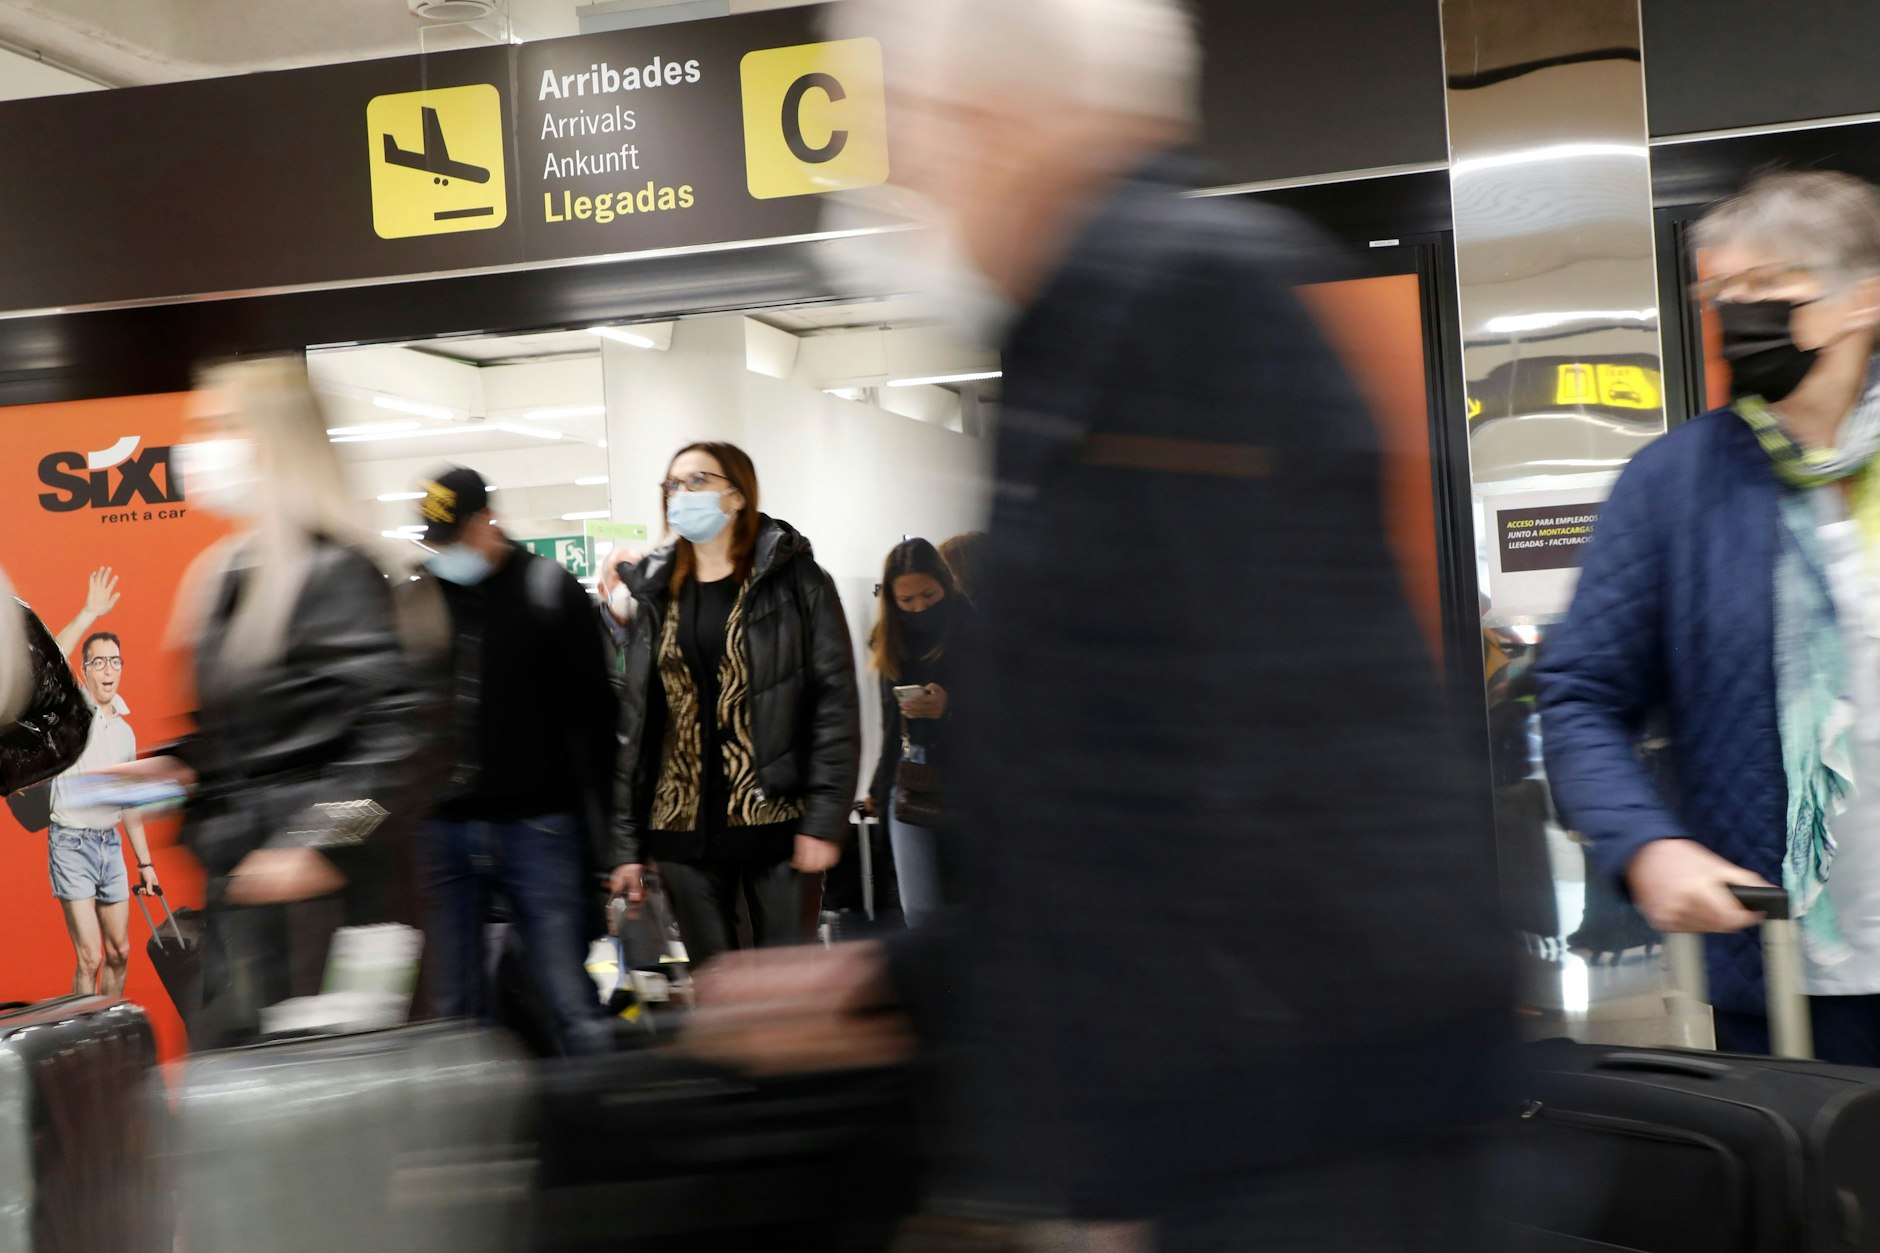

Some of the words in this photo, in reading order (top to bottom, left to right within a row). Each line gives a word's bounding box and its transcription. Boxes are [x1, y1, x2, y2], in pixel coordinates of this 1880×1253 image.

[539, 56, 701, 101] Arribades
[541, 105, 637, 140] Arrivals
[781, 72, 849, 164] C
[543, 144, 640, 179] Ankunft
[544, 181, 695, 224] Llegadas
[101, 511, 138, 523] rent
[143, 511, 153, 520] a
[158, 509, 187, 519] car
[1507, 520, 1534, 529] ACCESO
[1535, 518, 1555, 527] PARA
[1555, 515, 1598, 525] EMPLEADOS
[1508, 530, 1531, 539] JUNTO
[1539, 525, 1594, 536] MONTACARGAS
[1509, 540, 1544, 549] LLEGADAS
